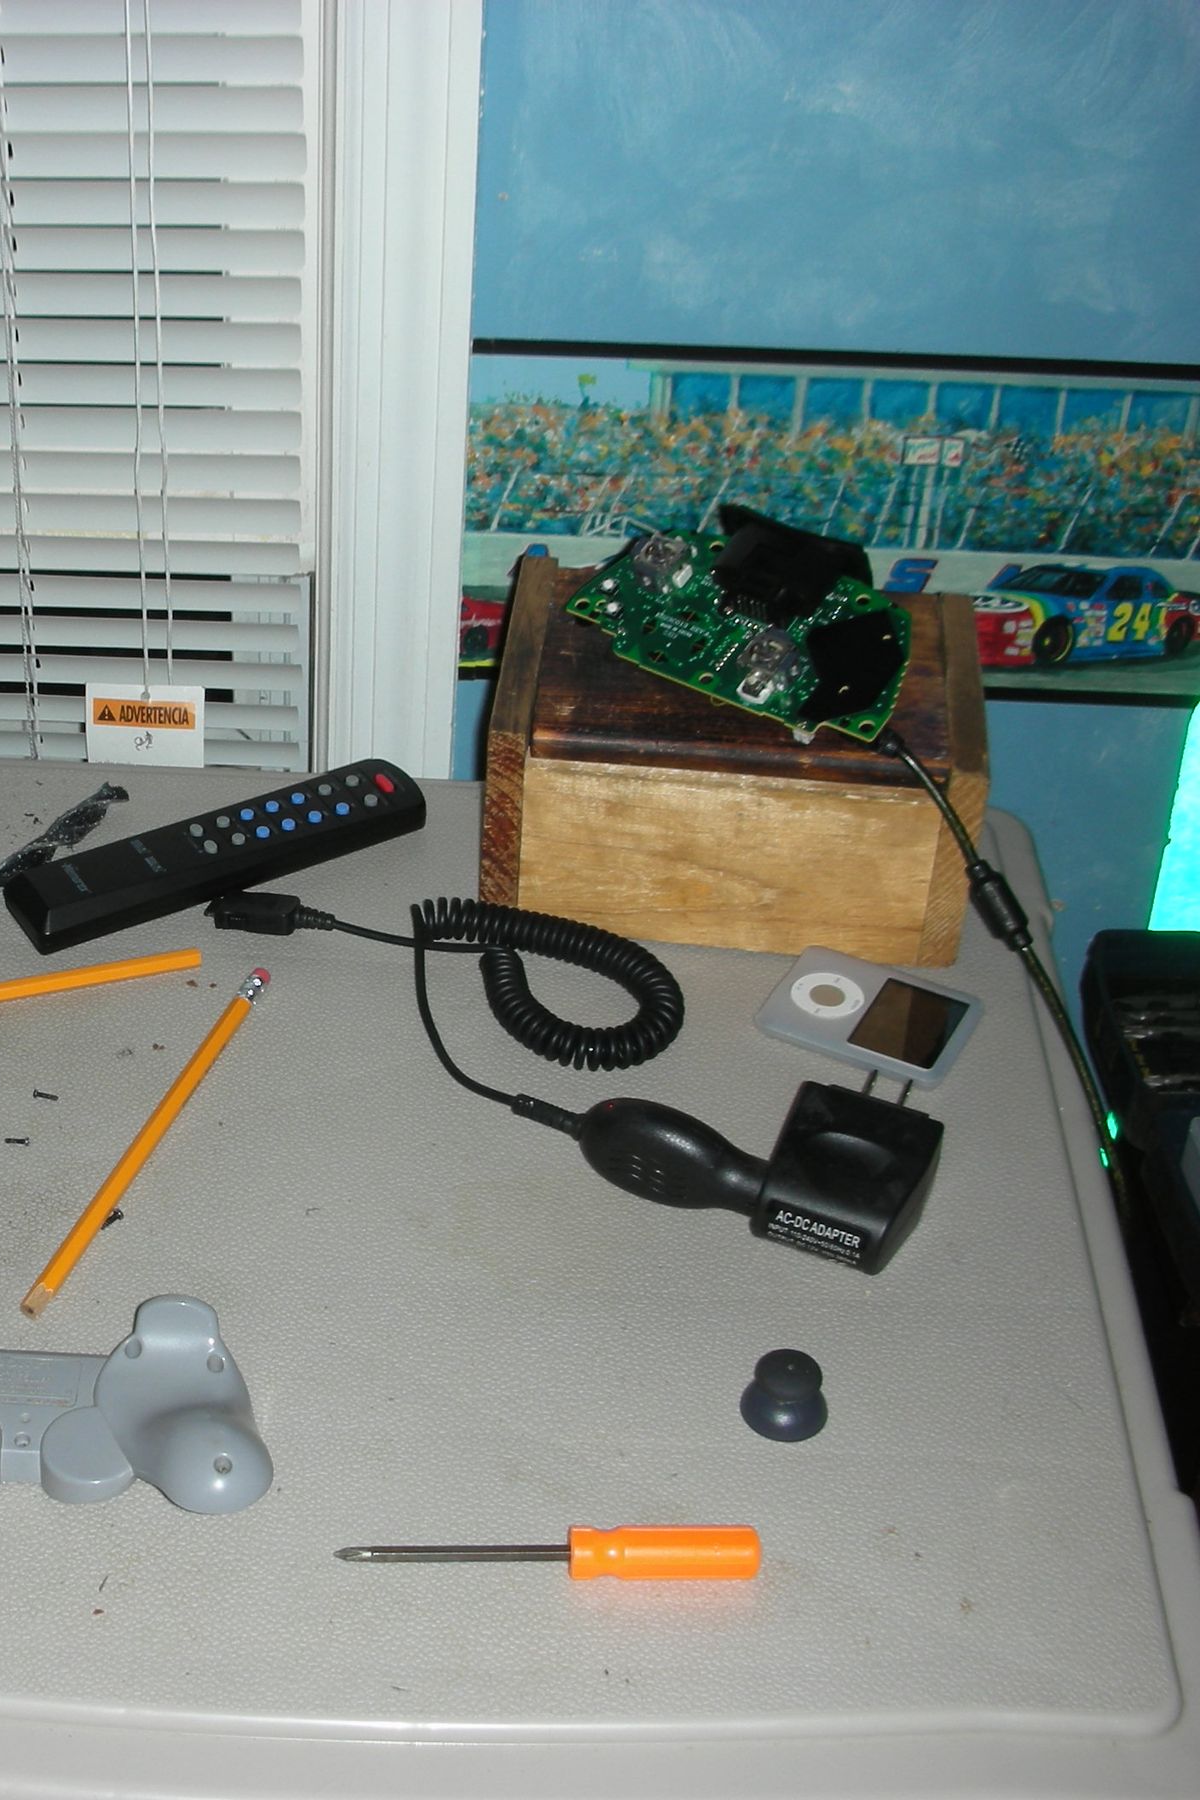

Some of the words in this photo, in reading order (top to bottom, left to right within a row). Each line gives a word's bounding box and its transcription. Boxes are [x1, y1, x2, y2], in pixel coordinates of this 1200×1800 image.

[1107, 602, 1152, 642] 24
[119, 704, 189, 725] ADVERTENCIA
[775, 1210, 810, 1230] AC-DC
[810, 1222, 861, 1248] ADAPTER
